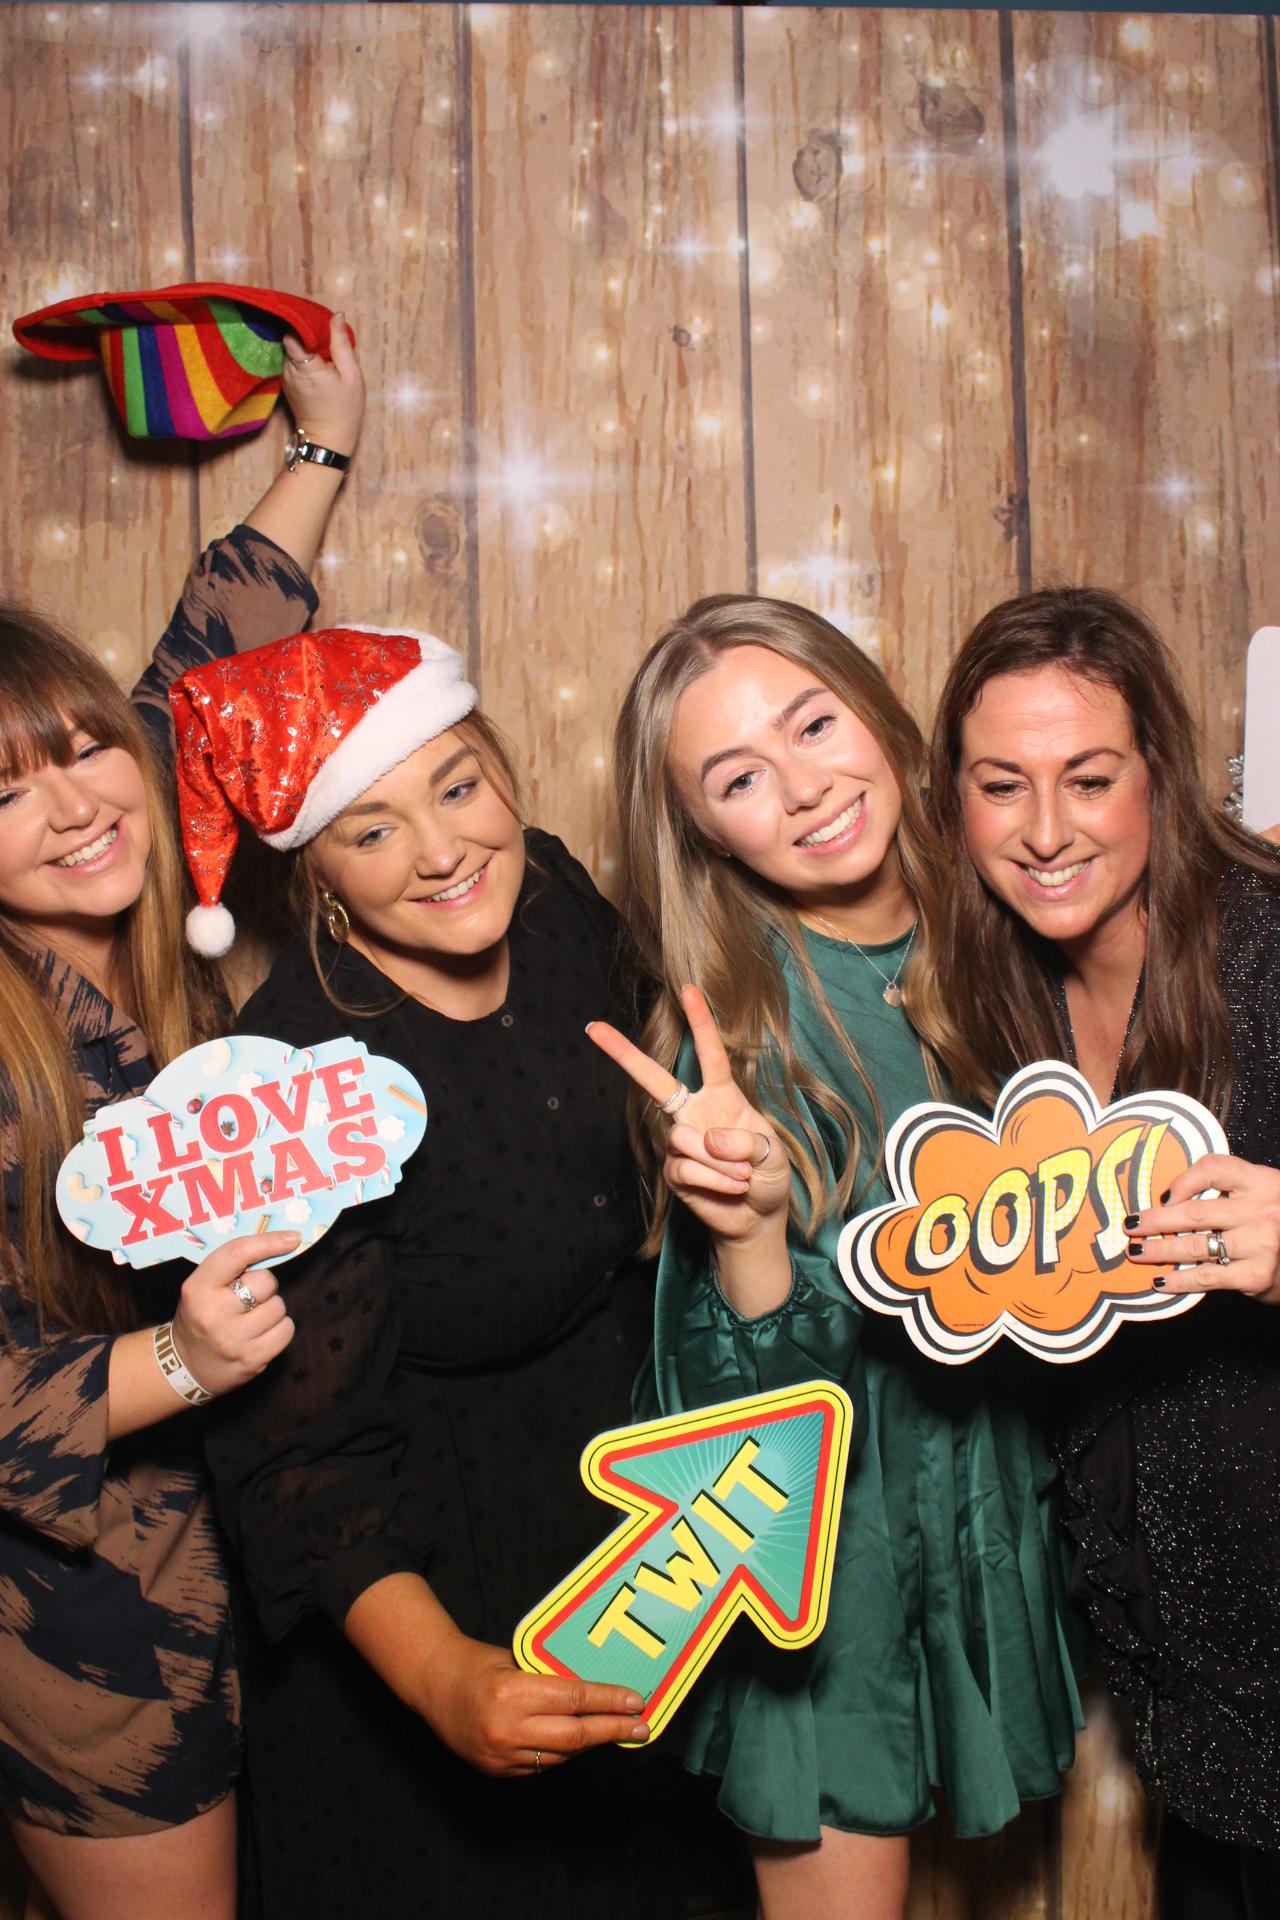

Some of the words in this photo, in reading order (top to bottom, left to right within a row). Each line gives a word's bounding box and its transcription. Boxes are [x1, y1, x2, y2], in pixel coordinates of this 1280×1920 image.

[97, 1126, 134, 1187] I
[146, 1056, 376, 1170] LOVE
[110, 1116, 387, 1247] XMAS
[587, 1435, 790, 1660] TWIT
